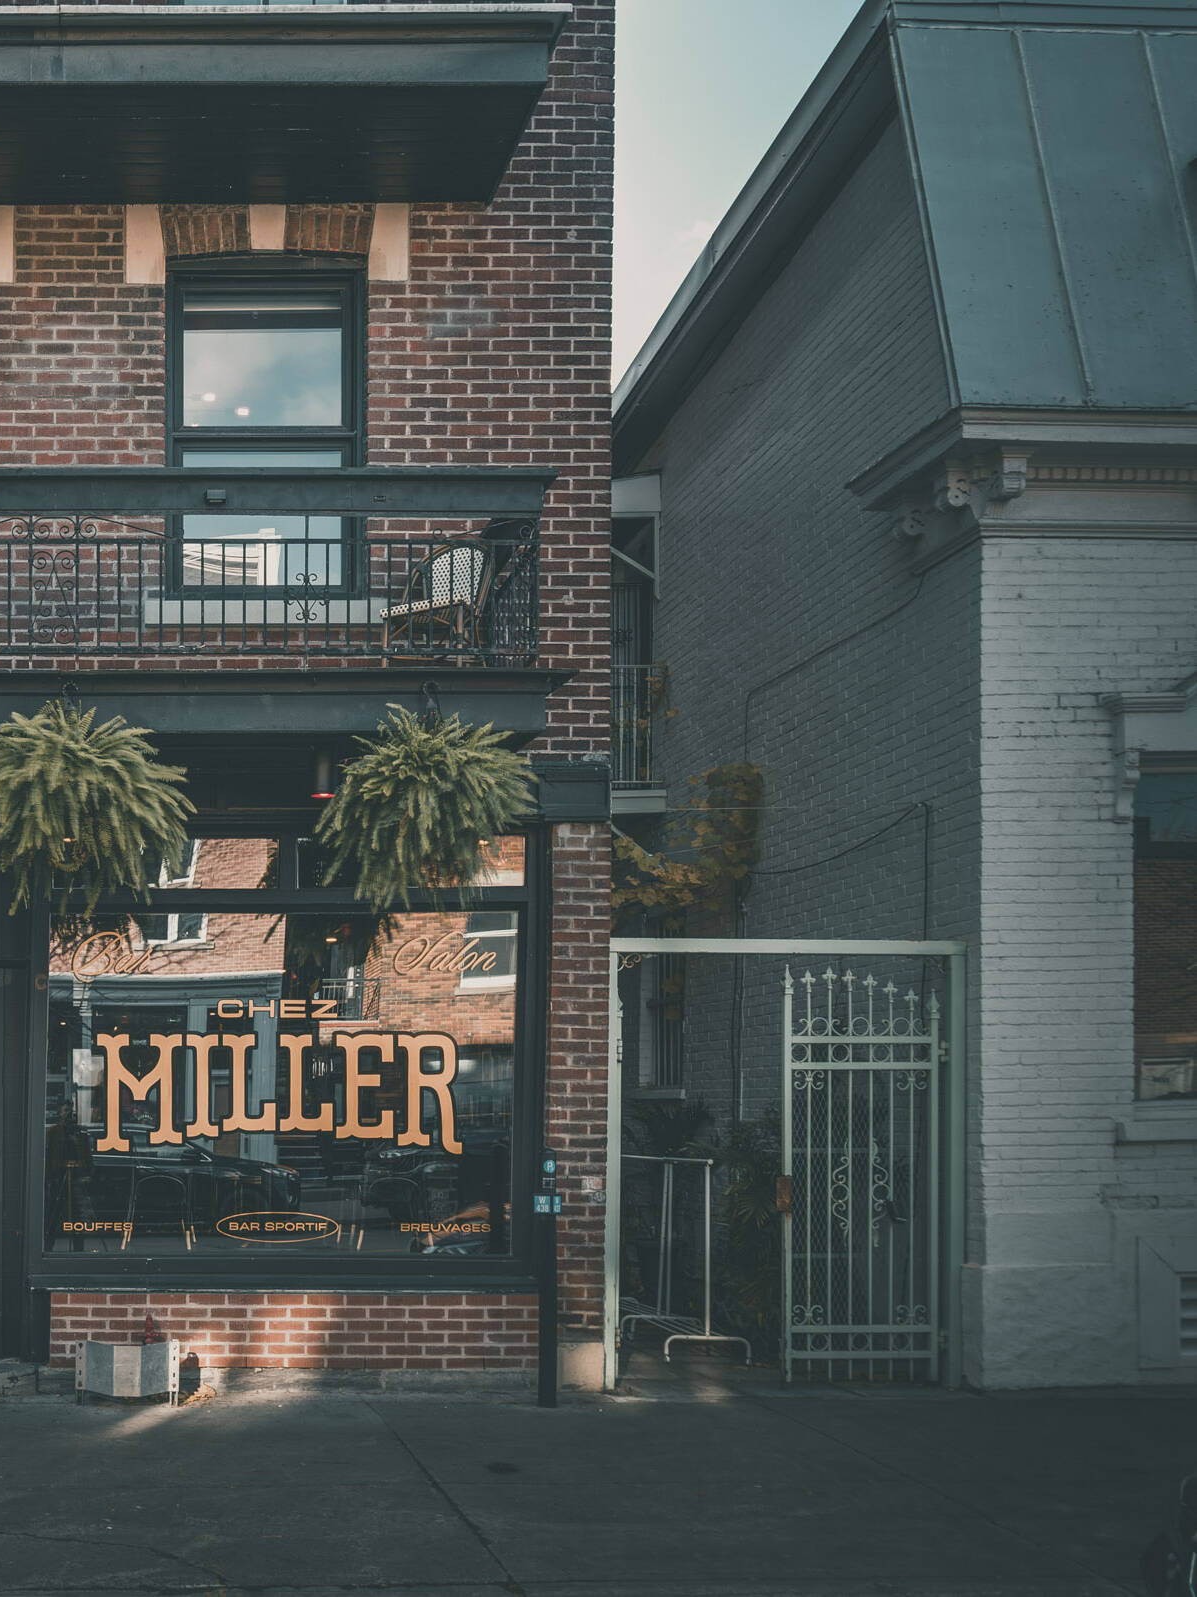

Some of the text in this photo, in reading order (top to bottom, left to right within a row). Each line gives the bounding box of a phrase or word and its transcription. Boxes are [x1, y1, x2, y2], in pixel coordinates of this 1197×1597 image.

[71, 931, 153, 983] Bar
[393, 930, 499, 976] Salon
[217, 999, 338, 1019] CHEZ
[95, 1032, 463, 1155] MILLER
[63, 1222, 133, 1232] BOUFFES
[228, 1221, 328, 1232] BAR SPORTIF
[400, 1223, 491, 1233] BREUVAGES
